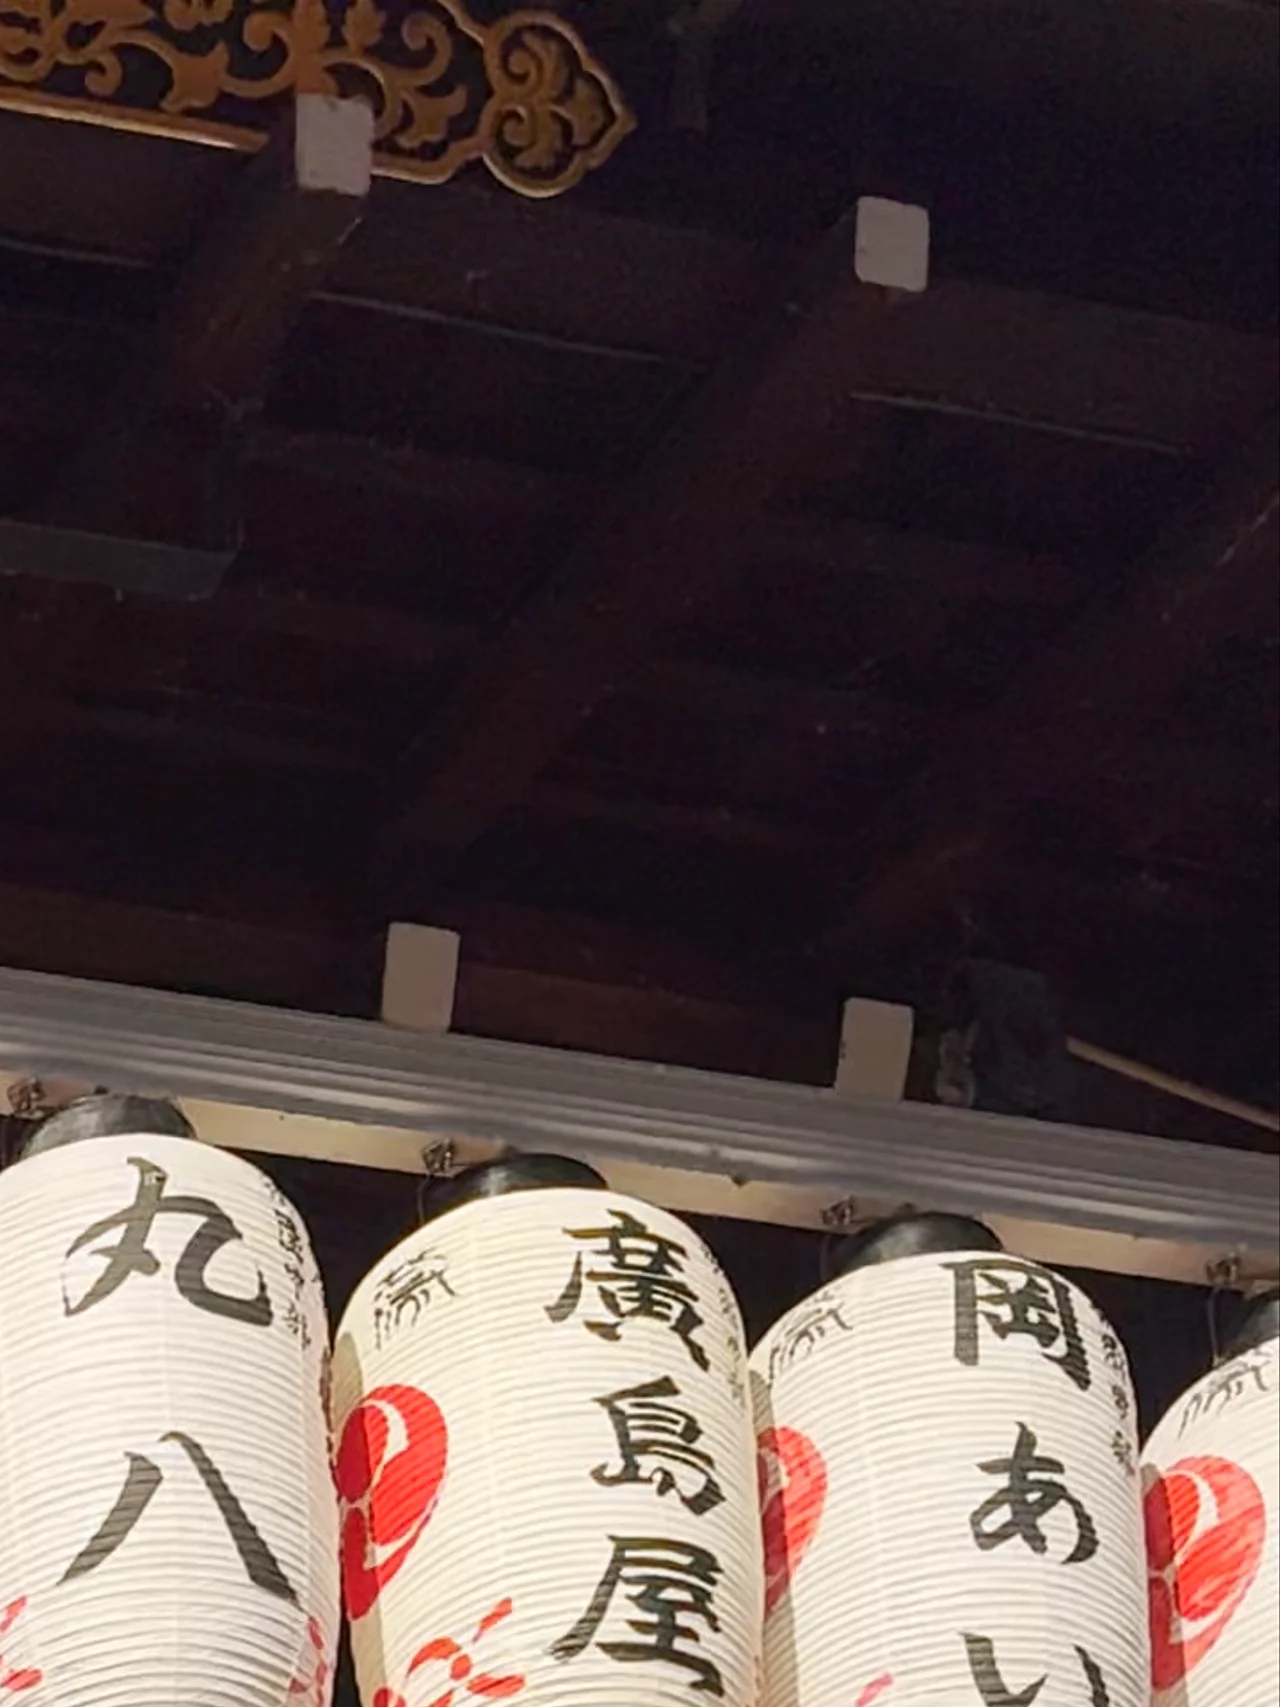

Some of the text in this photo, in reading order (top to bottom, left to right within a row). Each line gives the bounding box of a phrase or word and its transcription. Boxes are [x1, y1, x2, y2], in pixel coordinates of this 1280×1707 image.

[57, 1157, 299, 1602] 丸八
[544, 1209, 725, 1697] 廣島屋
